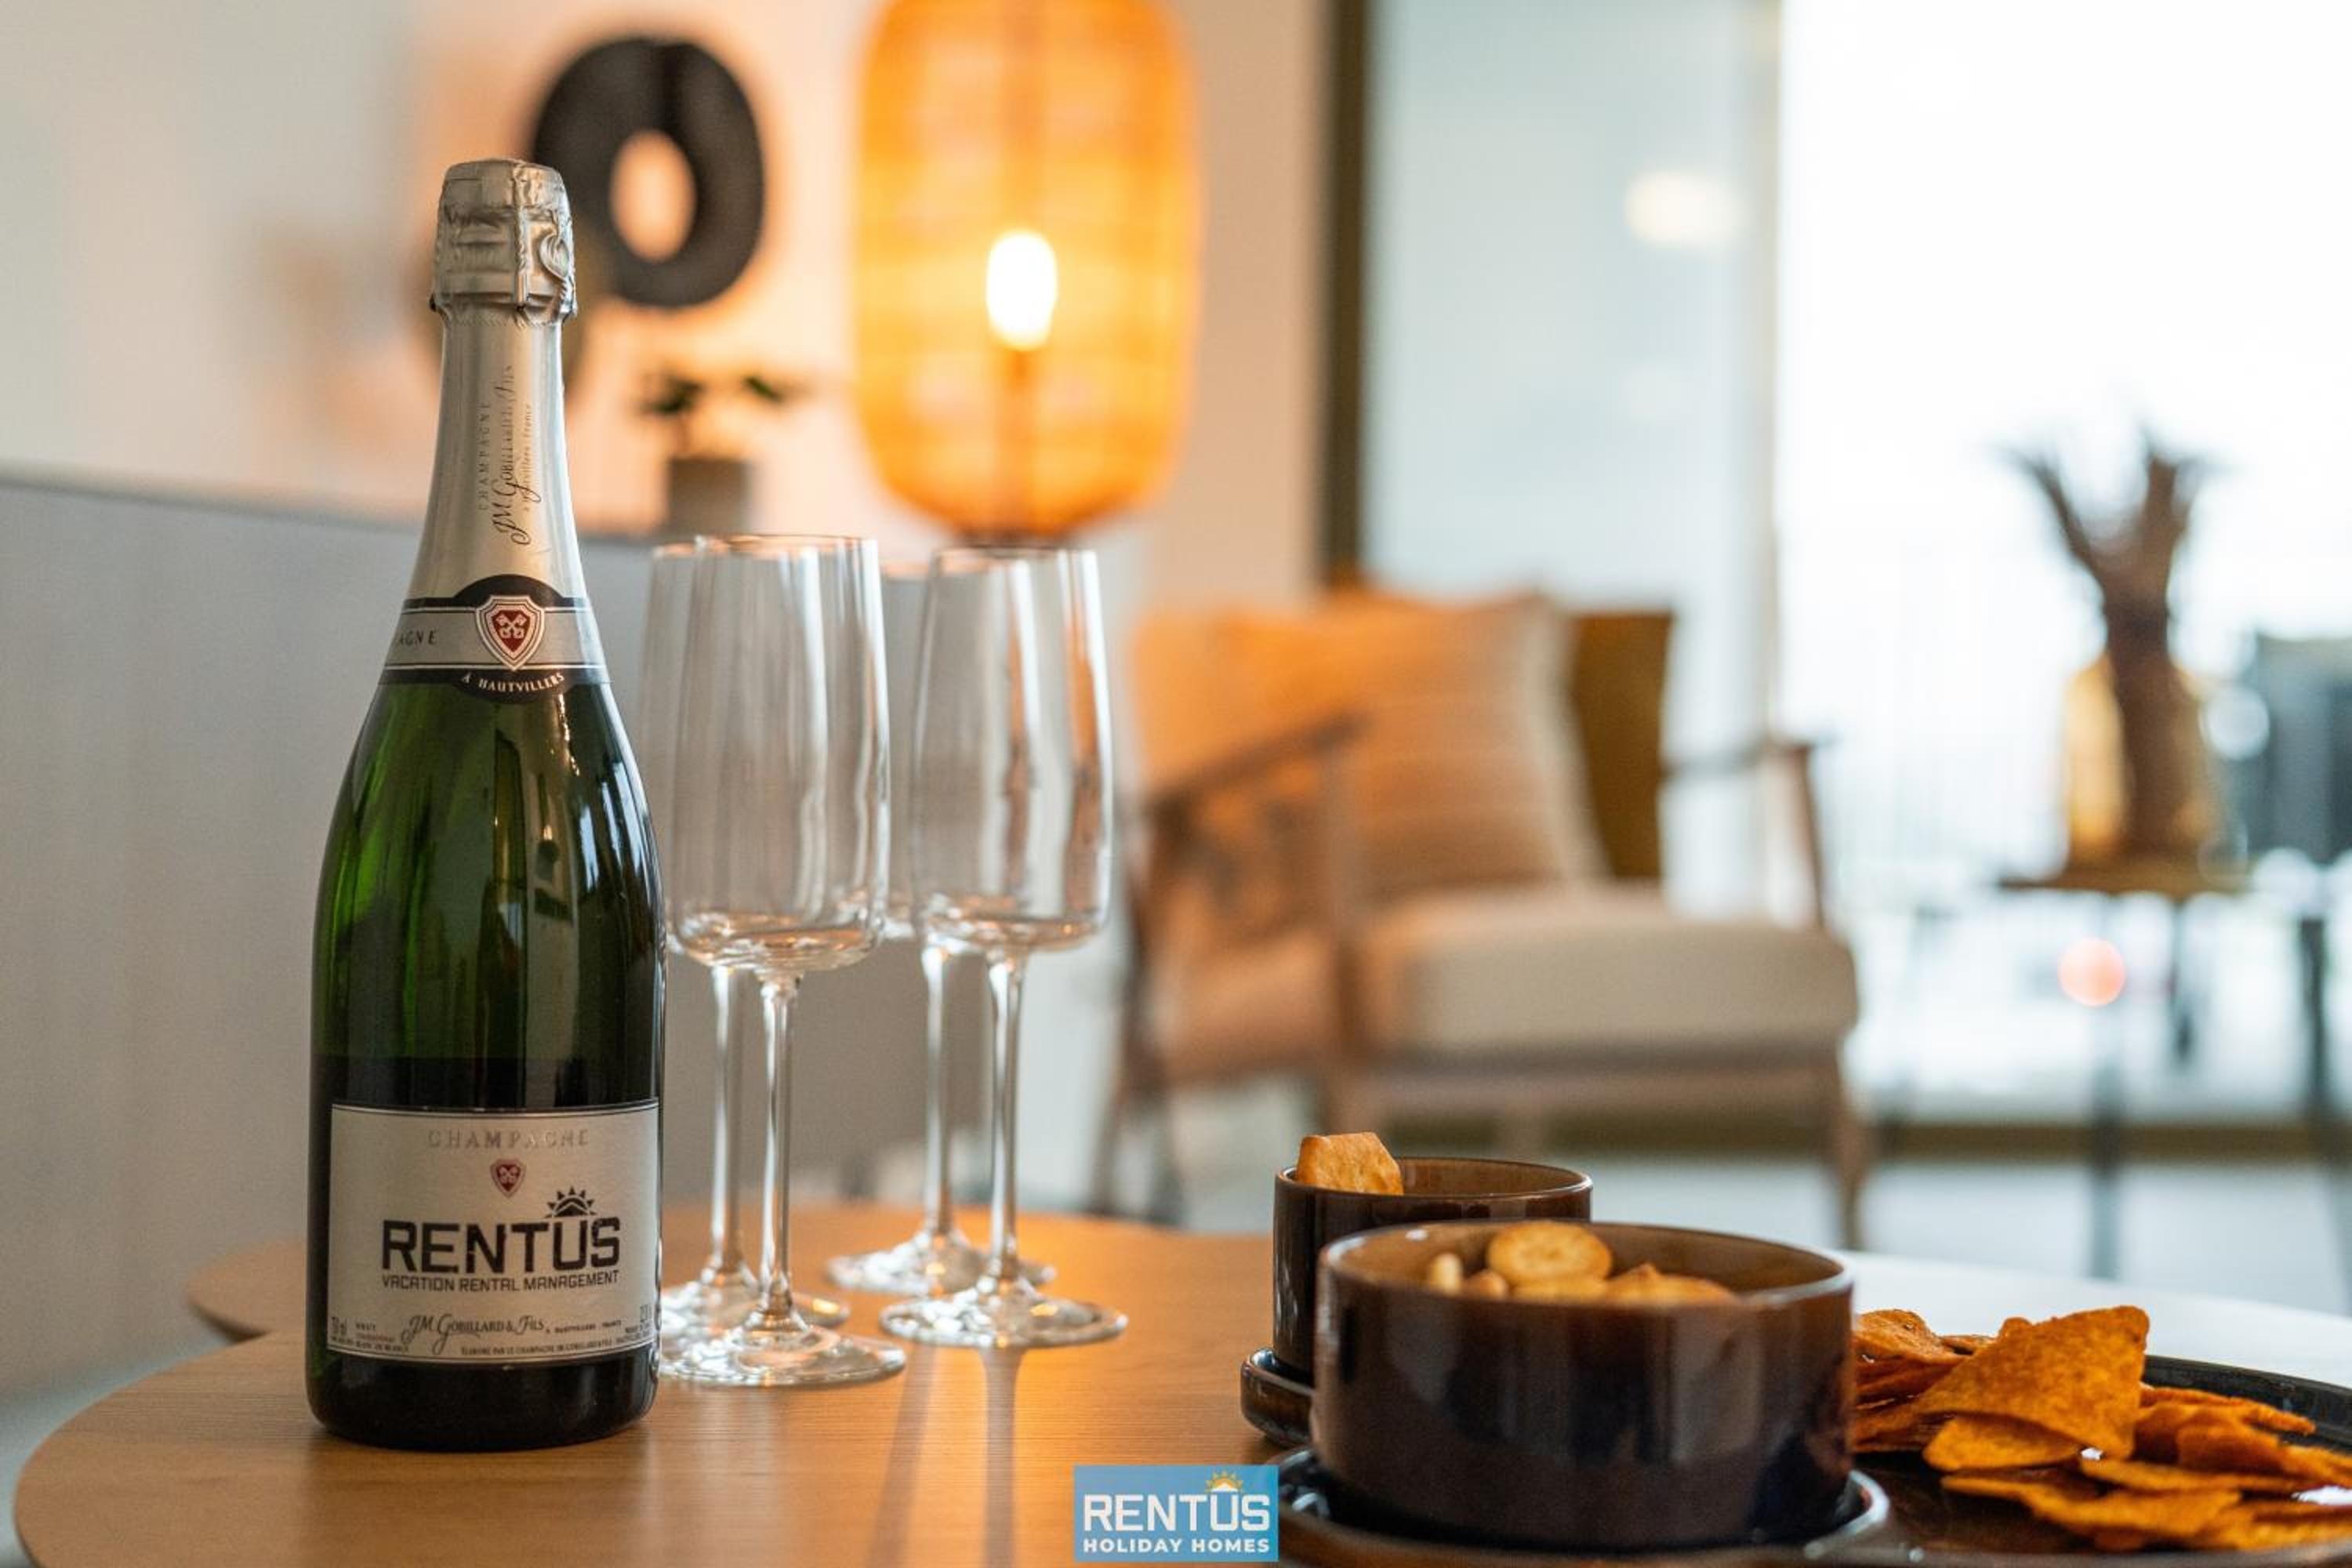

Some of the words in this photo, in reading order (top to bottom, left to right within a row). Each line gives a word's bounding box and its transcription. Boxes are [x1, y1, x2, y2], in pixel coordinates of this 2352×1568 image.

[478, 403, 490, 510] CHAMPAGNE
[428, 1128, 589, 1149] CHAMPAGNE
[382, 1217, 621, 1275] RENTUS
[382, 1275, 455, 1293] VACATION
[458, 1278, 520, 1293] RENTAL
[523, 1269, 620, 1292] MANAGEMENT
